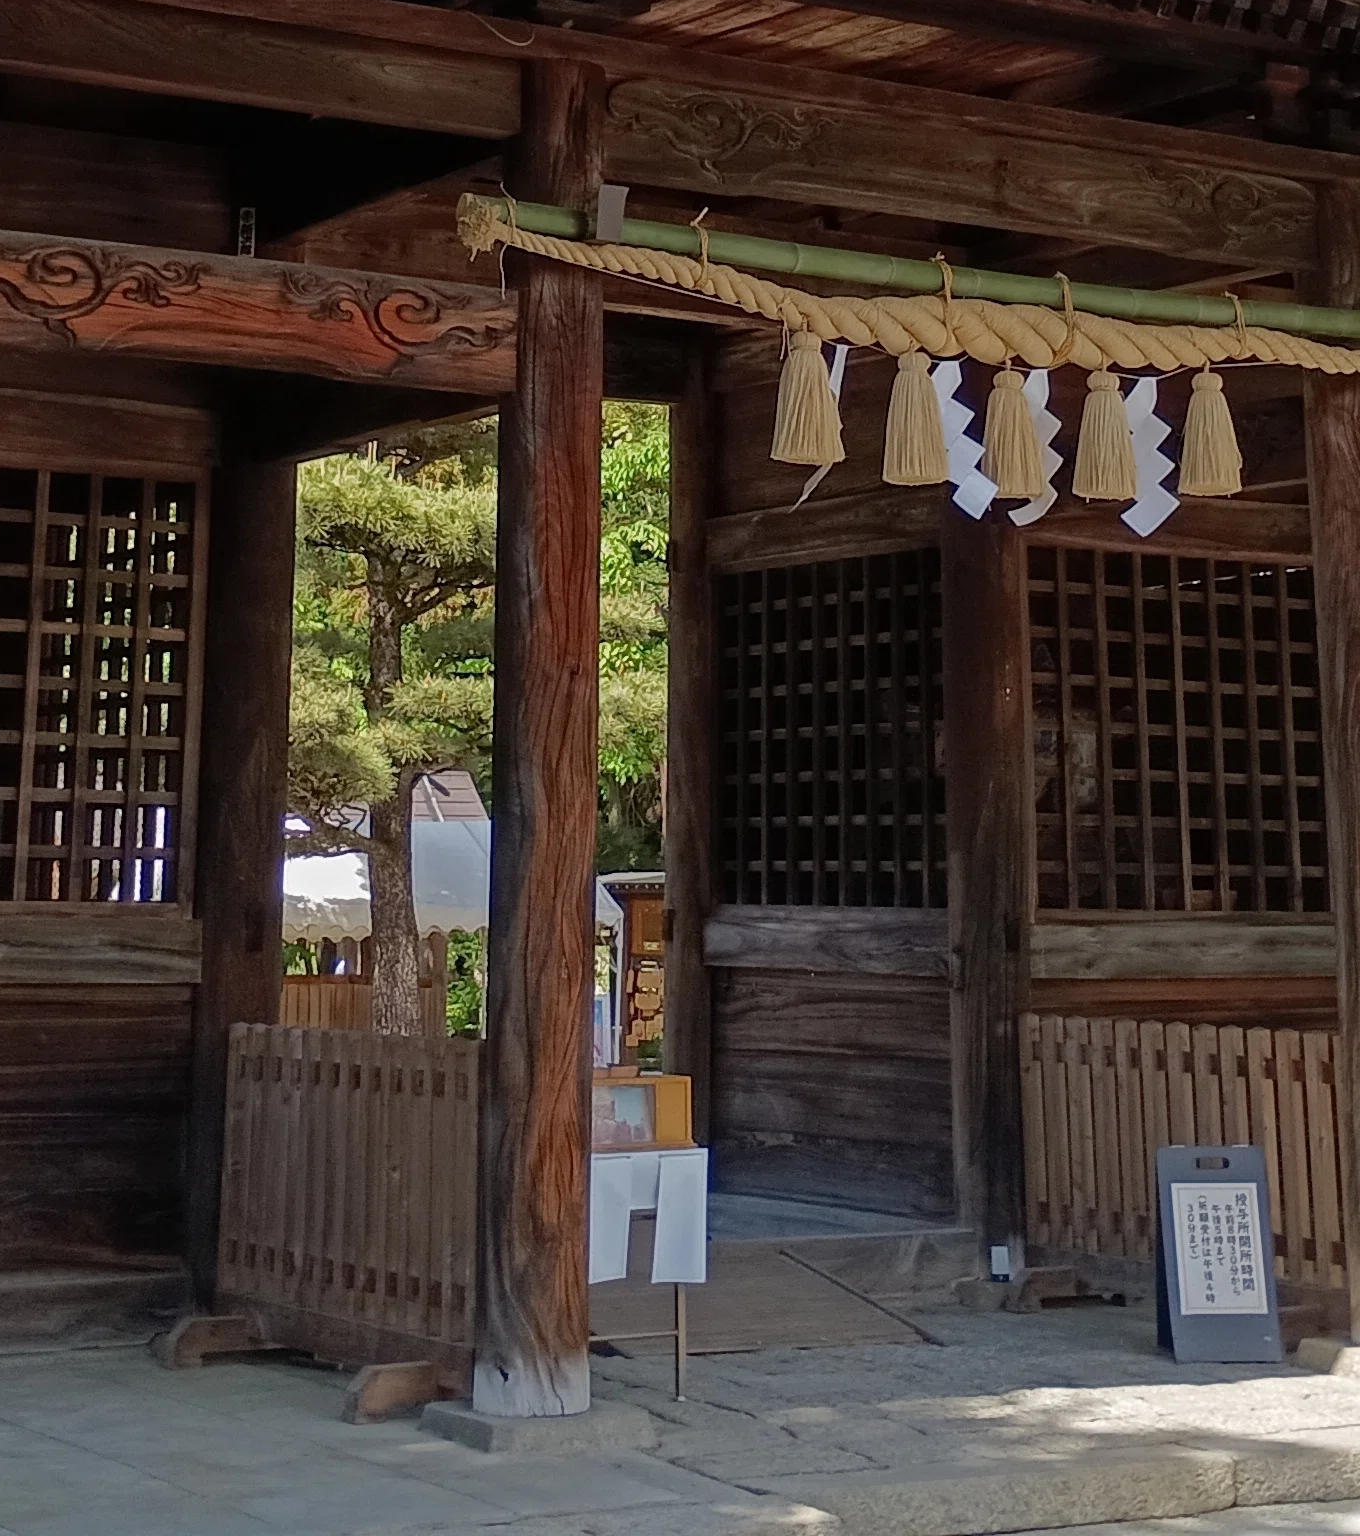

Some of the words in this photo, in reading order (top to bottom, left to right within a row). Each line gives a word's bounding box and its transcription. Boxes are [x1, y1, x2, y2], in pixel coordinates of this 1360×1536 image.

[1235, 1193, 1255, 1291] 授与所開所時間
